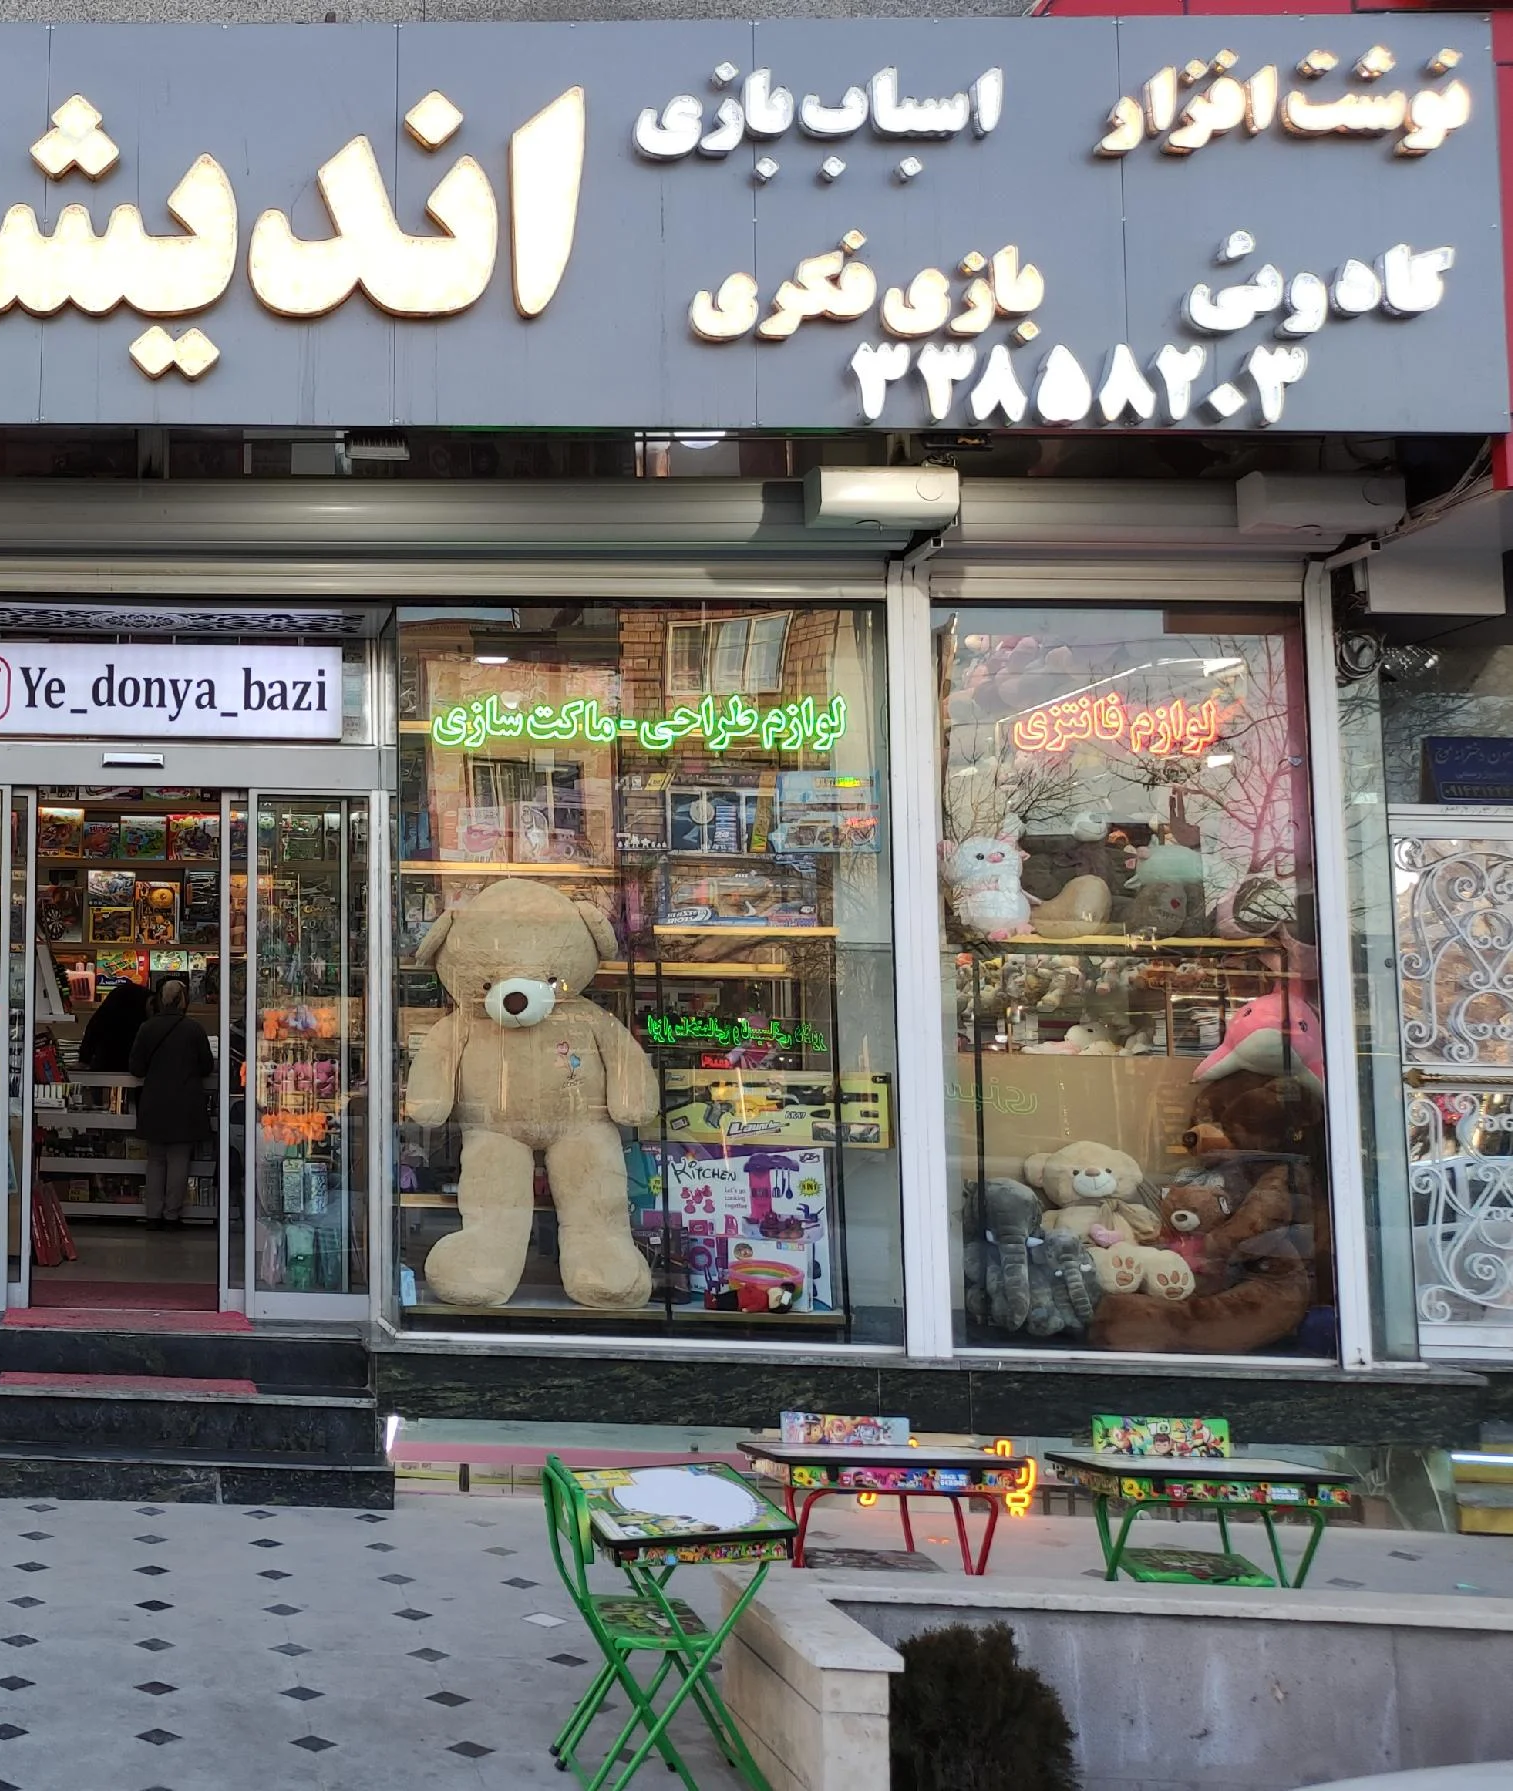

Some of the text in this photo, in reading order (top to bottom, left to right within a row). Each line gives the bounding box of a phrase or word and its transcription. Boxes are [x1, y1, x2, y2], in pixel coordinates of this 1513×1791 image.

[634, 61, 1006, 181] اسباب بازی
[1093, 47, 1472, 157] نوشت افزار
[691, 229, 1045, 347] بازی فکری
[20, 663, 329, 722] Ye_donya_bazi
[432, 693, 524, 747] سازی
[639, 694, 758, 751] طراحی
[762, 695, 848, 751] لوازم
[1012, 690, 1220, 756] لوازم فانتزی
